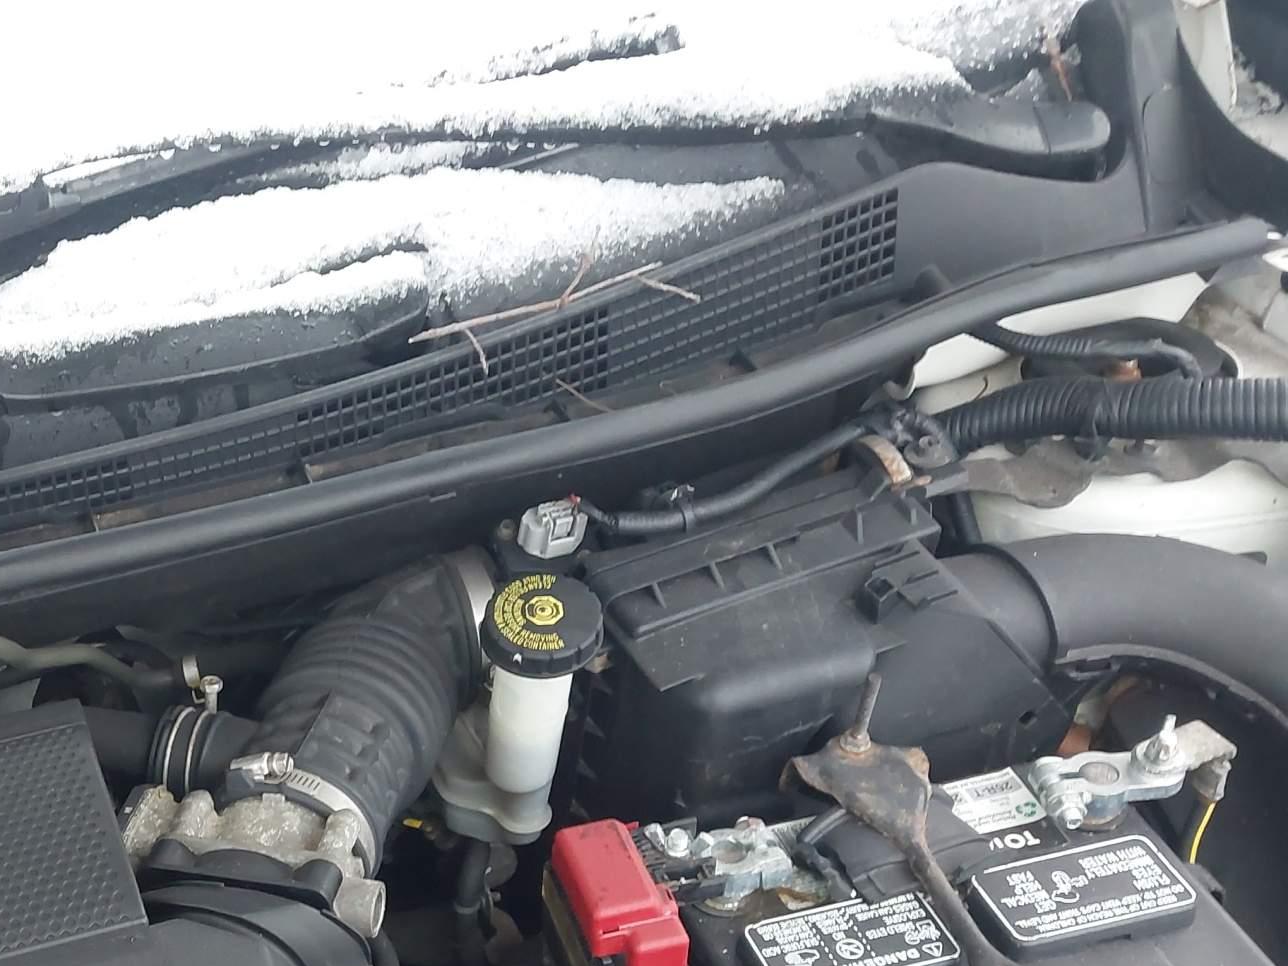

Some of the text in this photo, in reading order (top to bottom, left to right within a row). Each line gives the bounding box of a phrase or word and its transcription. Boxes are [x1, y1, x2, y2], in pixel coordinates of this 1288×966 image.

[1116, 846, 1146, 860] WITH
[1084, 854, 1154, 880] IMMEDIATELY
[1006, 870, 1034, 886] FAST
[1014, 880, 1042, 895] HELP
[1001, 889, 1050, 909] MEDICAL
[1034, 899, 1057, 914] GET
